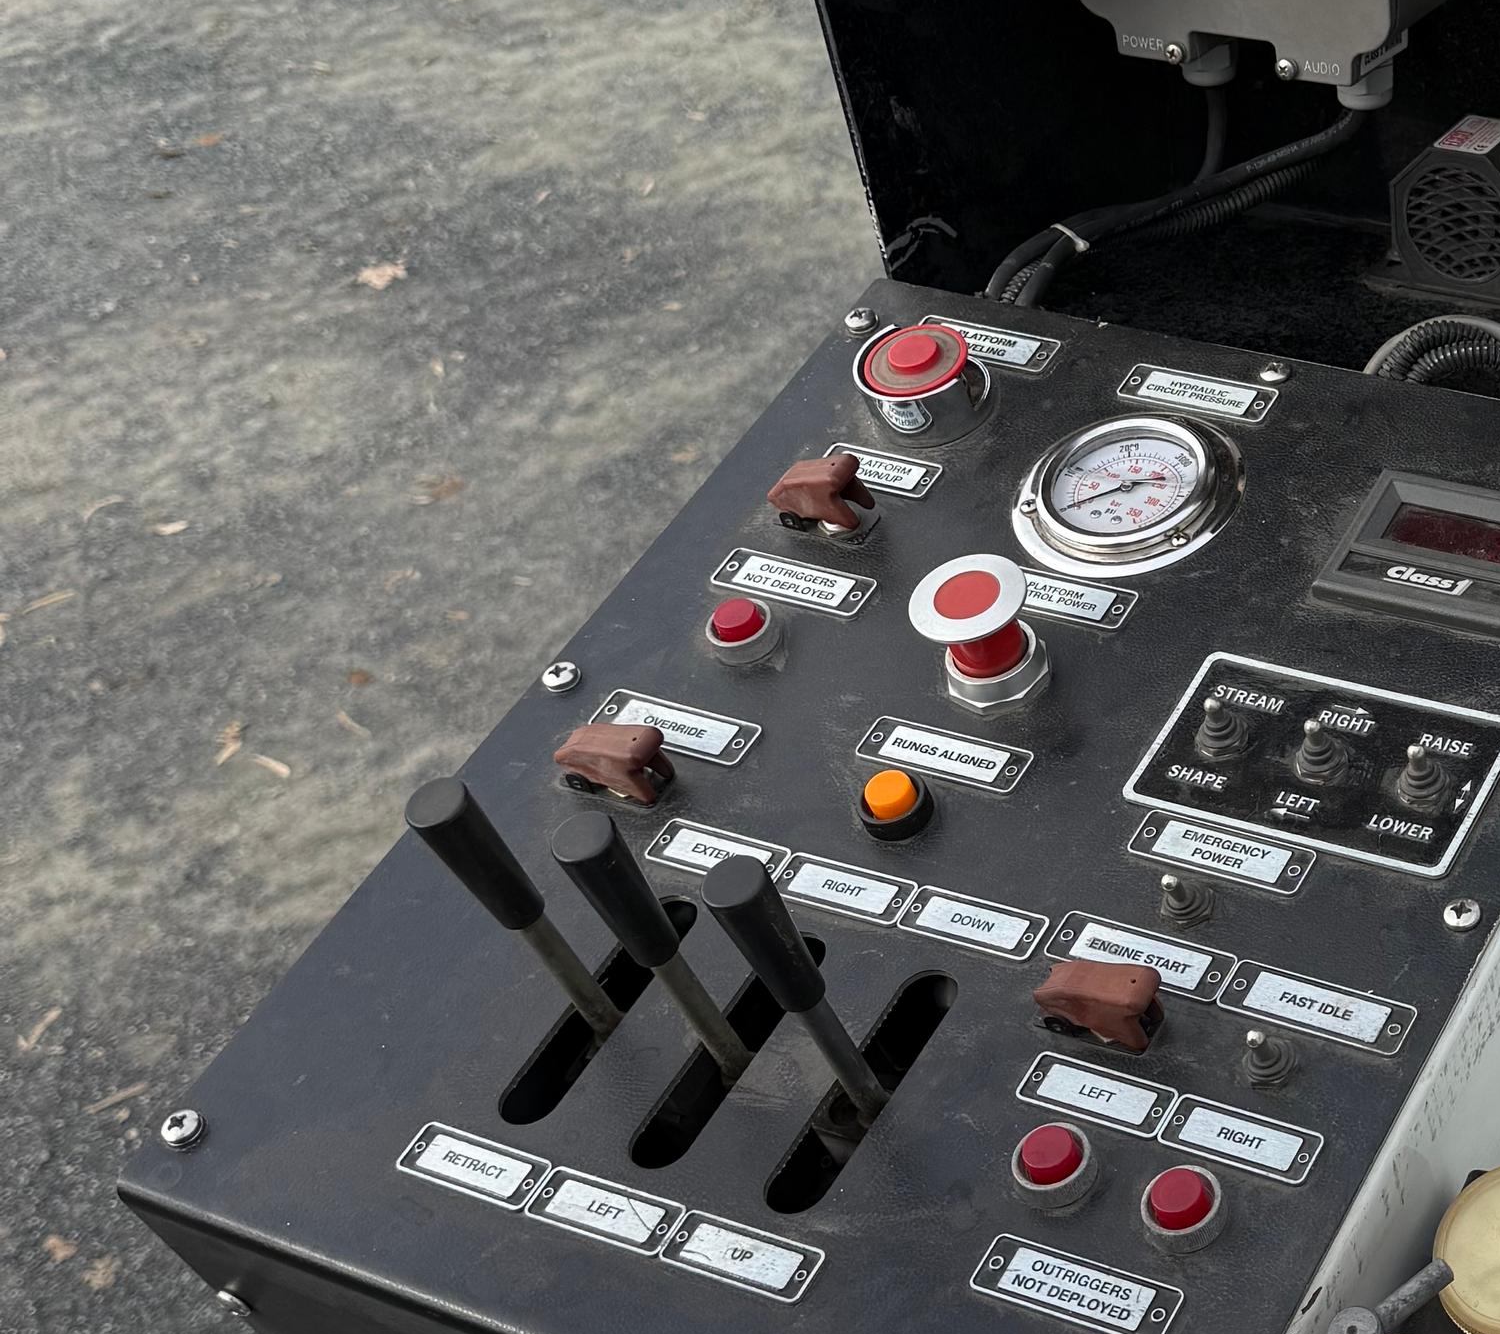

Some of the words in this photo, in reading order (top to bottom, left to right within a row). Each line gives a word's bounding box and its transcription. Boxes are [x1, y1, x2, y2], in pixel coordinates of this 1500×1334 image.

[1122, 34, 1164, 52] POWER
[1303, 60, 1340, 76] AUDIO
[967, 342, 1006, 357] VELING
[1146, 383, 1187, 397] CIRCUIT
[1188, 392, 1246, 409] PRESSURE
[1170, 381, 1231, 398] HYDRAULIC
[857, 467, 903, 483] OWN/UP
[1127, 465, 1142, 475] 150
[1088, 482, 1100, 491] 50
[1144, 496, 1160, 506] 300
[1126, 507, 1143, 518] 350
[743, 572, 773, 585] NOT
[771, 578, 836, 601] DEPLOYED
[760, 563, 837, 588] OUTRIGGERS
[1027, 581, 1085, 600] PLATFORM
[1027, 590, 1054, 603] TROL
[1056, 597, 1098, 612] POWER
[1214, 684, 1285, 712] STREAM
[643, 715, 708, 739] OVERRIDE
[1318, 709, 1376, 734] RIGHT
[891, 736, 939, 756] RUNGS
[938, 750, 997, 770] ALIGNED
[1419, 733, 1474, 756] RAISE
[1167, 764, 1228, 790] SHAPE
[1275, 790, 1320, 812] LEFT
[1368, 813, 1434, 841] LOWER
[691, 842, 736, 860] EXTEN
[1182, 829, 1272, 859] EMERGENCY
[1191, 847, 1244, 869] POWER
[822, 879, 867, 897] RIGHT
[950, 912, 995, 933] DOWN
[1088, 937, 1145, 962] ENGINE
[1144, 954, 1192, 975] START
[1279, 991, 1319, 1010] FAST
[1318, 1003, 1354, 1021] IDLE
[1078, 1084, 1117, 1103] LEFT
[1217, 1127, 1266, 1149] RIGHT
[443, 1150, 507, 1179] RETRACT
[587, 1200, 626, 1220] LEFT
[731, 1247, 754, 1261] UP
[1031, 1260, 1133, 1301] OUTRIGGERS
[1011, 1274, 1048, 1293] NOT
[1047, 1285, 1131, 1321] DEPLOYED
